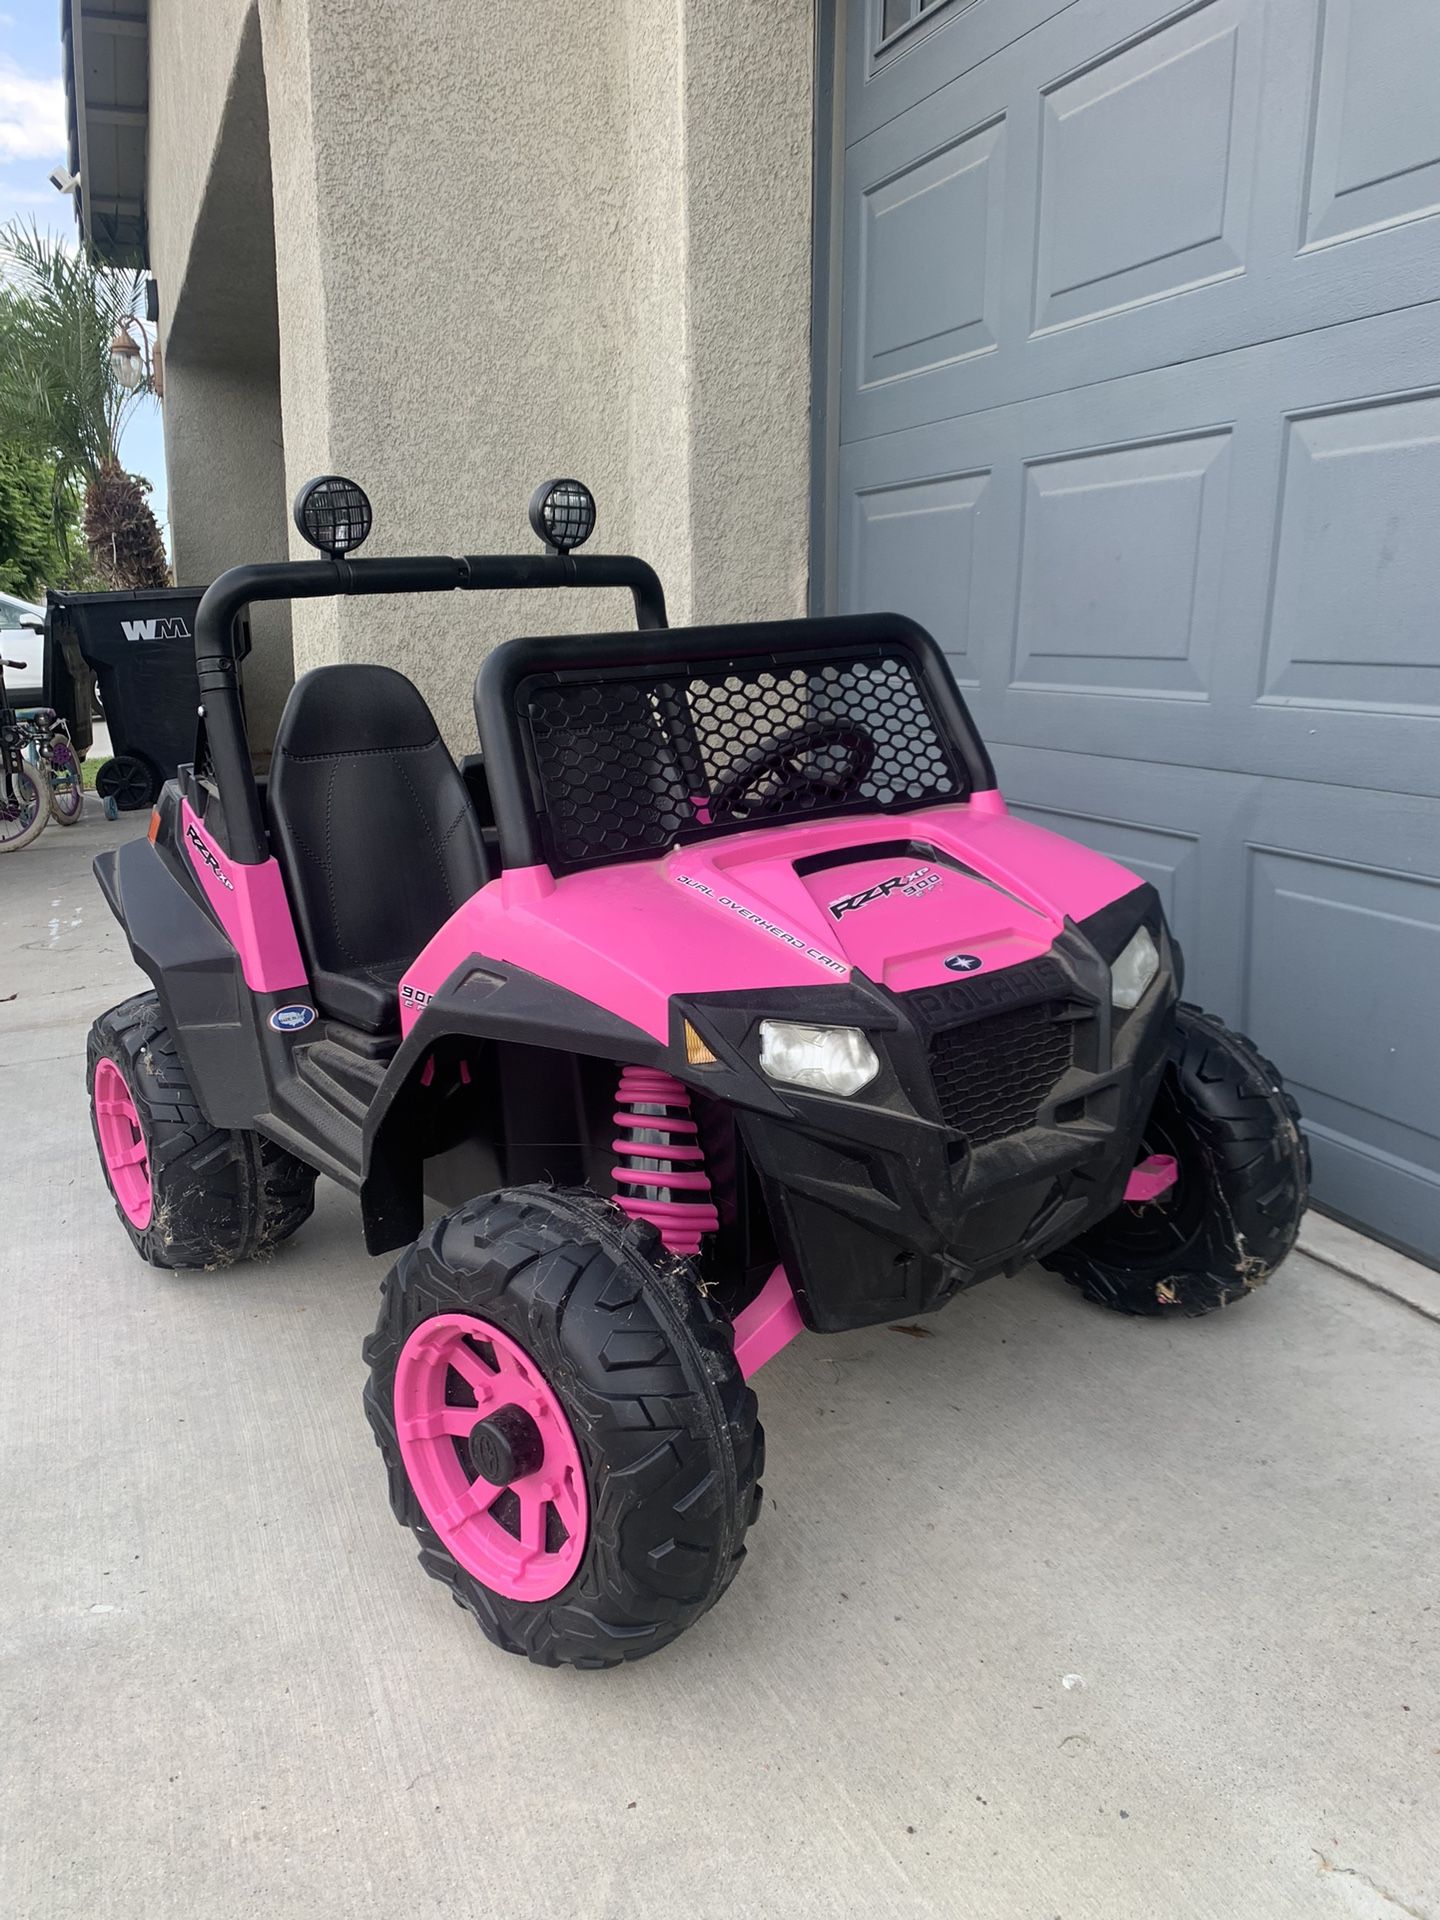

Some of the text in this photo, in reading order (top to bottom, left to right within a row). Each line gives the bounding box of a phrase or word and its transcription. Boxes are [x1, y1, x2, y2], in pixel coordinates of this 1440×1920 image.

[120, 617, 192, 642] WM
[828, 876, 906, 921] RZR
[902, 873, 942, 897] 900
[676, 875, 847, 974] DUAL OVERHEAD CAM
